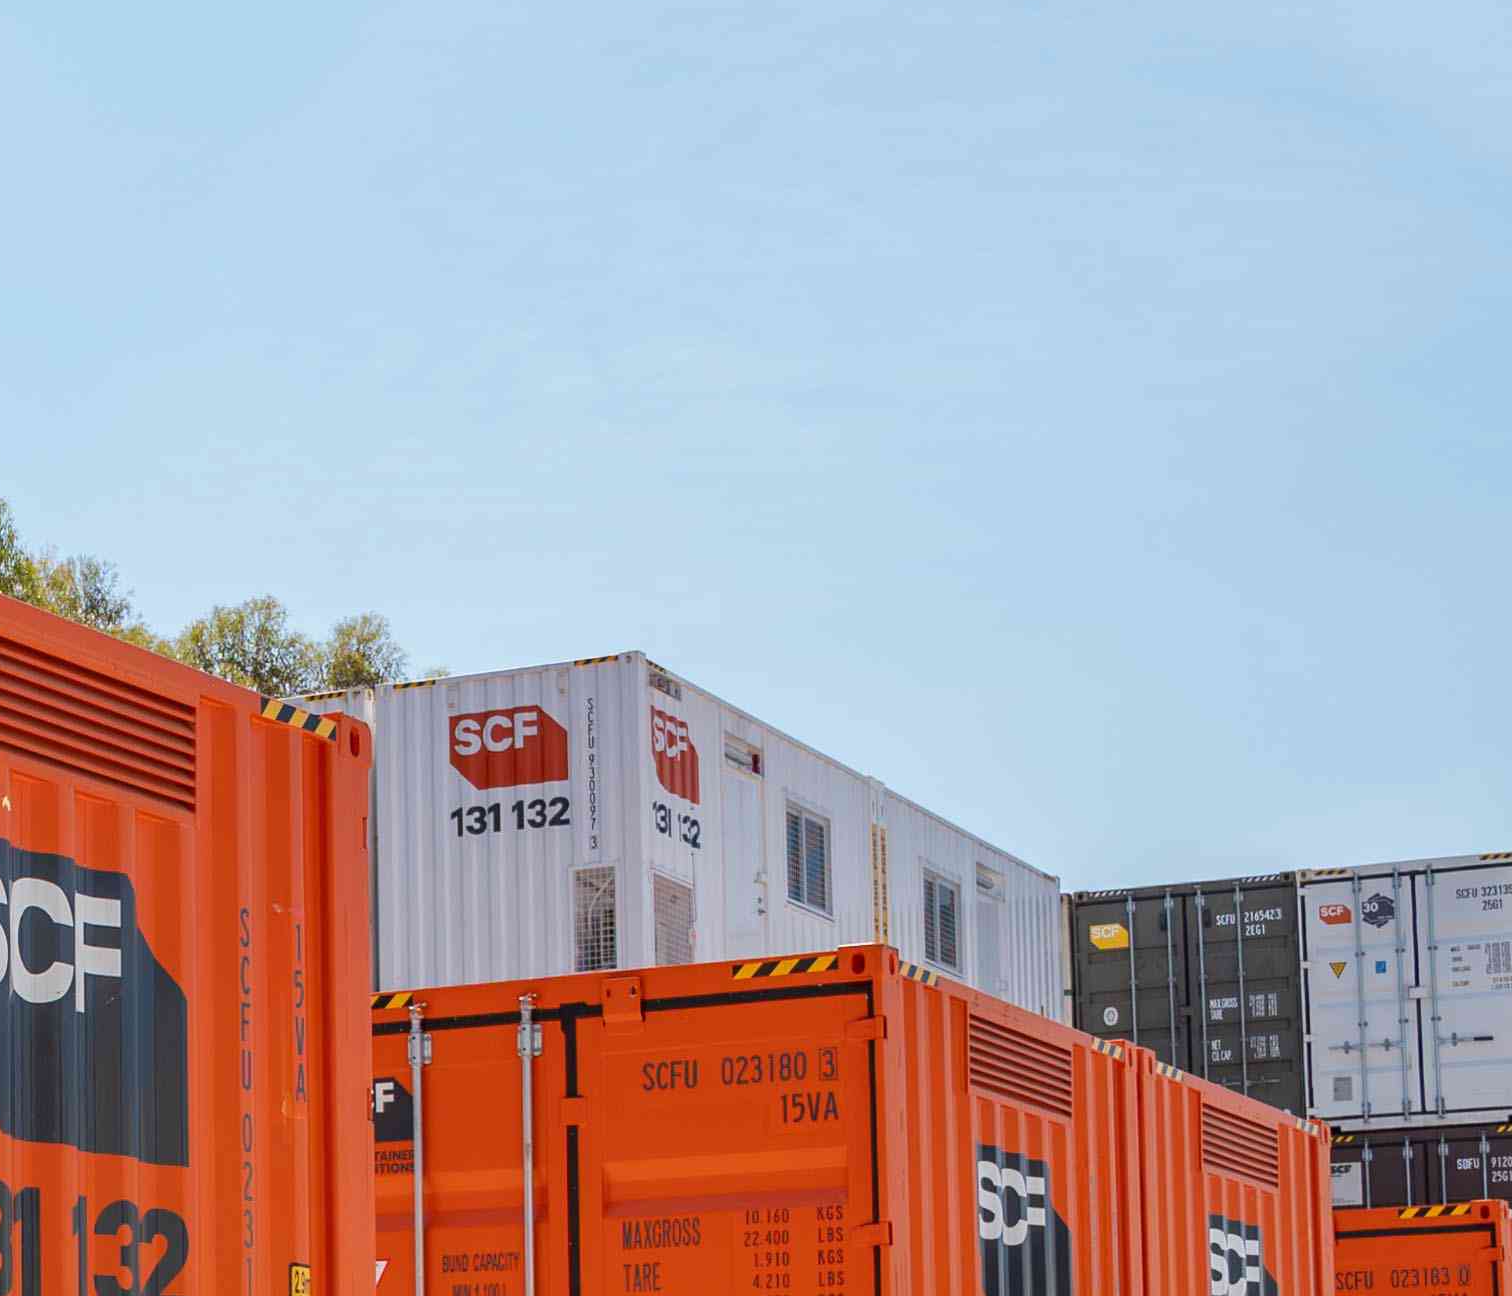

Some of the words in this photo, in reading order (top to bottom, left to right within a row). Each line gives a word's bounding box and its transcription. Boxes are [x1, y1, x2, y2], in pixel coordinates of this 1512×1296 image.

[454, 712, 539, 756] SCF
[654, 715, 688, 760] SCF
[450, 801, 501, 837] 131
[512, 796, 570, 830] 132
[1456, 889, 1477, 899] SCFU
[1320, 906, 1345, 917] SCF
[1363, 903, 1378, 913] 30
[1482, 899, 1503, 911] 25G1
[293, 923, 306, 1104] 15VA
[641, 1059, 699, 1092] SCFU
[721, 1051, 808, 1086] 023180
[780, 1091, 839, 1123] 15VA
[1491, 1171, 1512, 1183] 25G1
[816, 1206, 844, 1221] KGS
[978, 1160, 1046, 1246] SCF
[622, 1216, 701, 1250] MAXGROSS
[818, 1227, 844, 1244] LBS
[442, 1254, 468, 1273] BUND
[473, 1253, 519, 1272] CAPACITY
[753, 1252, 790, 1268] 1.910
[818, 1249, 844, 1265] KGS
[623, 1262, 662, 1293] TARE
[752, 1274, 791, 1289] 4.210
[818, 1271, 845, 1287] LBS
[1336, 1271, 1374, 1290] SCFU
[1391, 1267, 1450, 1288] 023183
